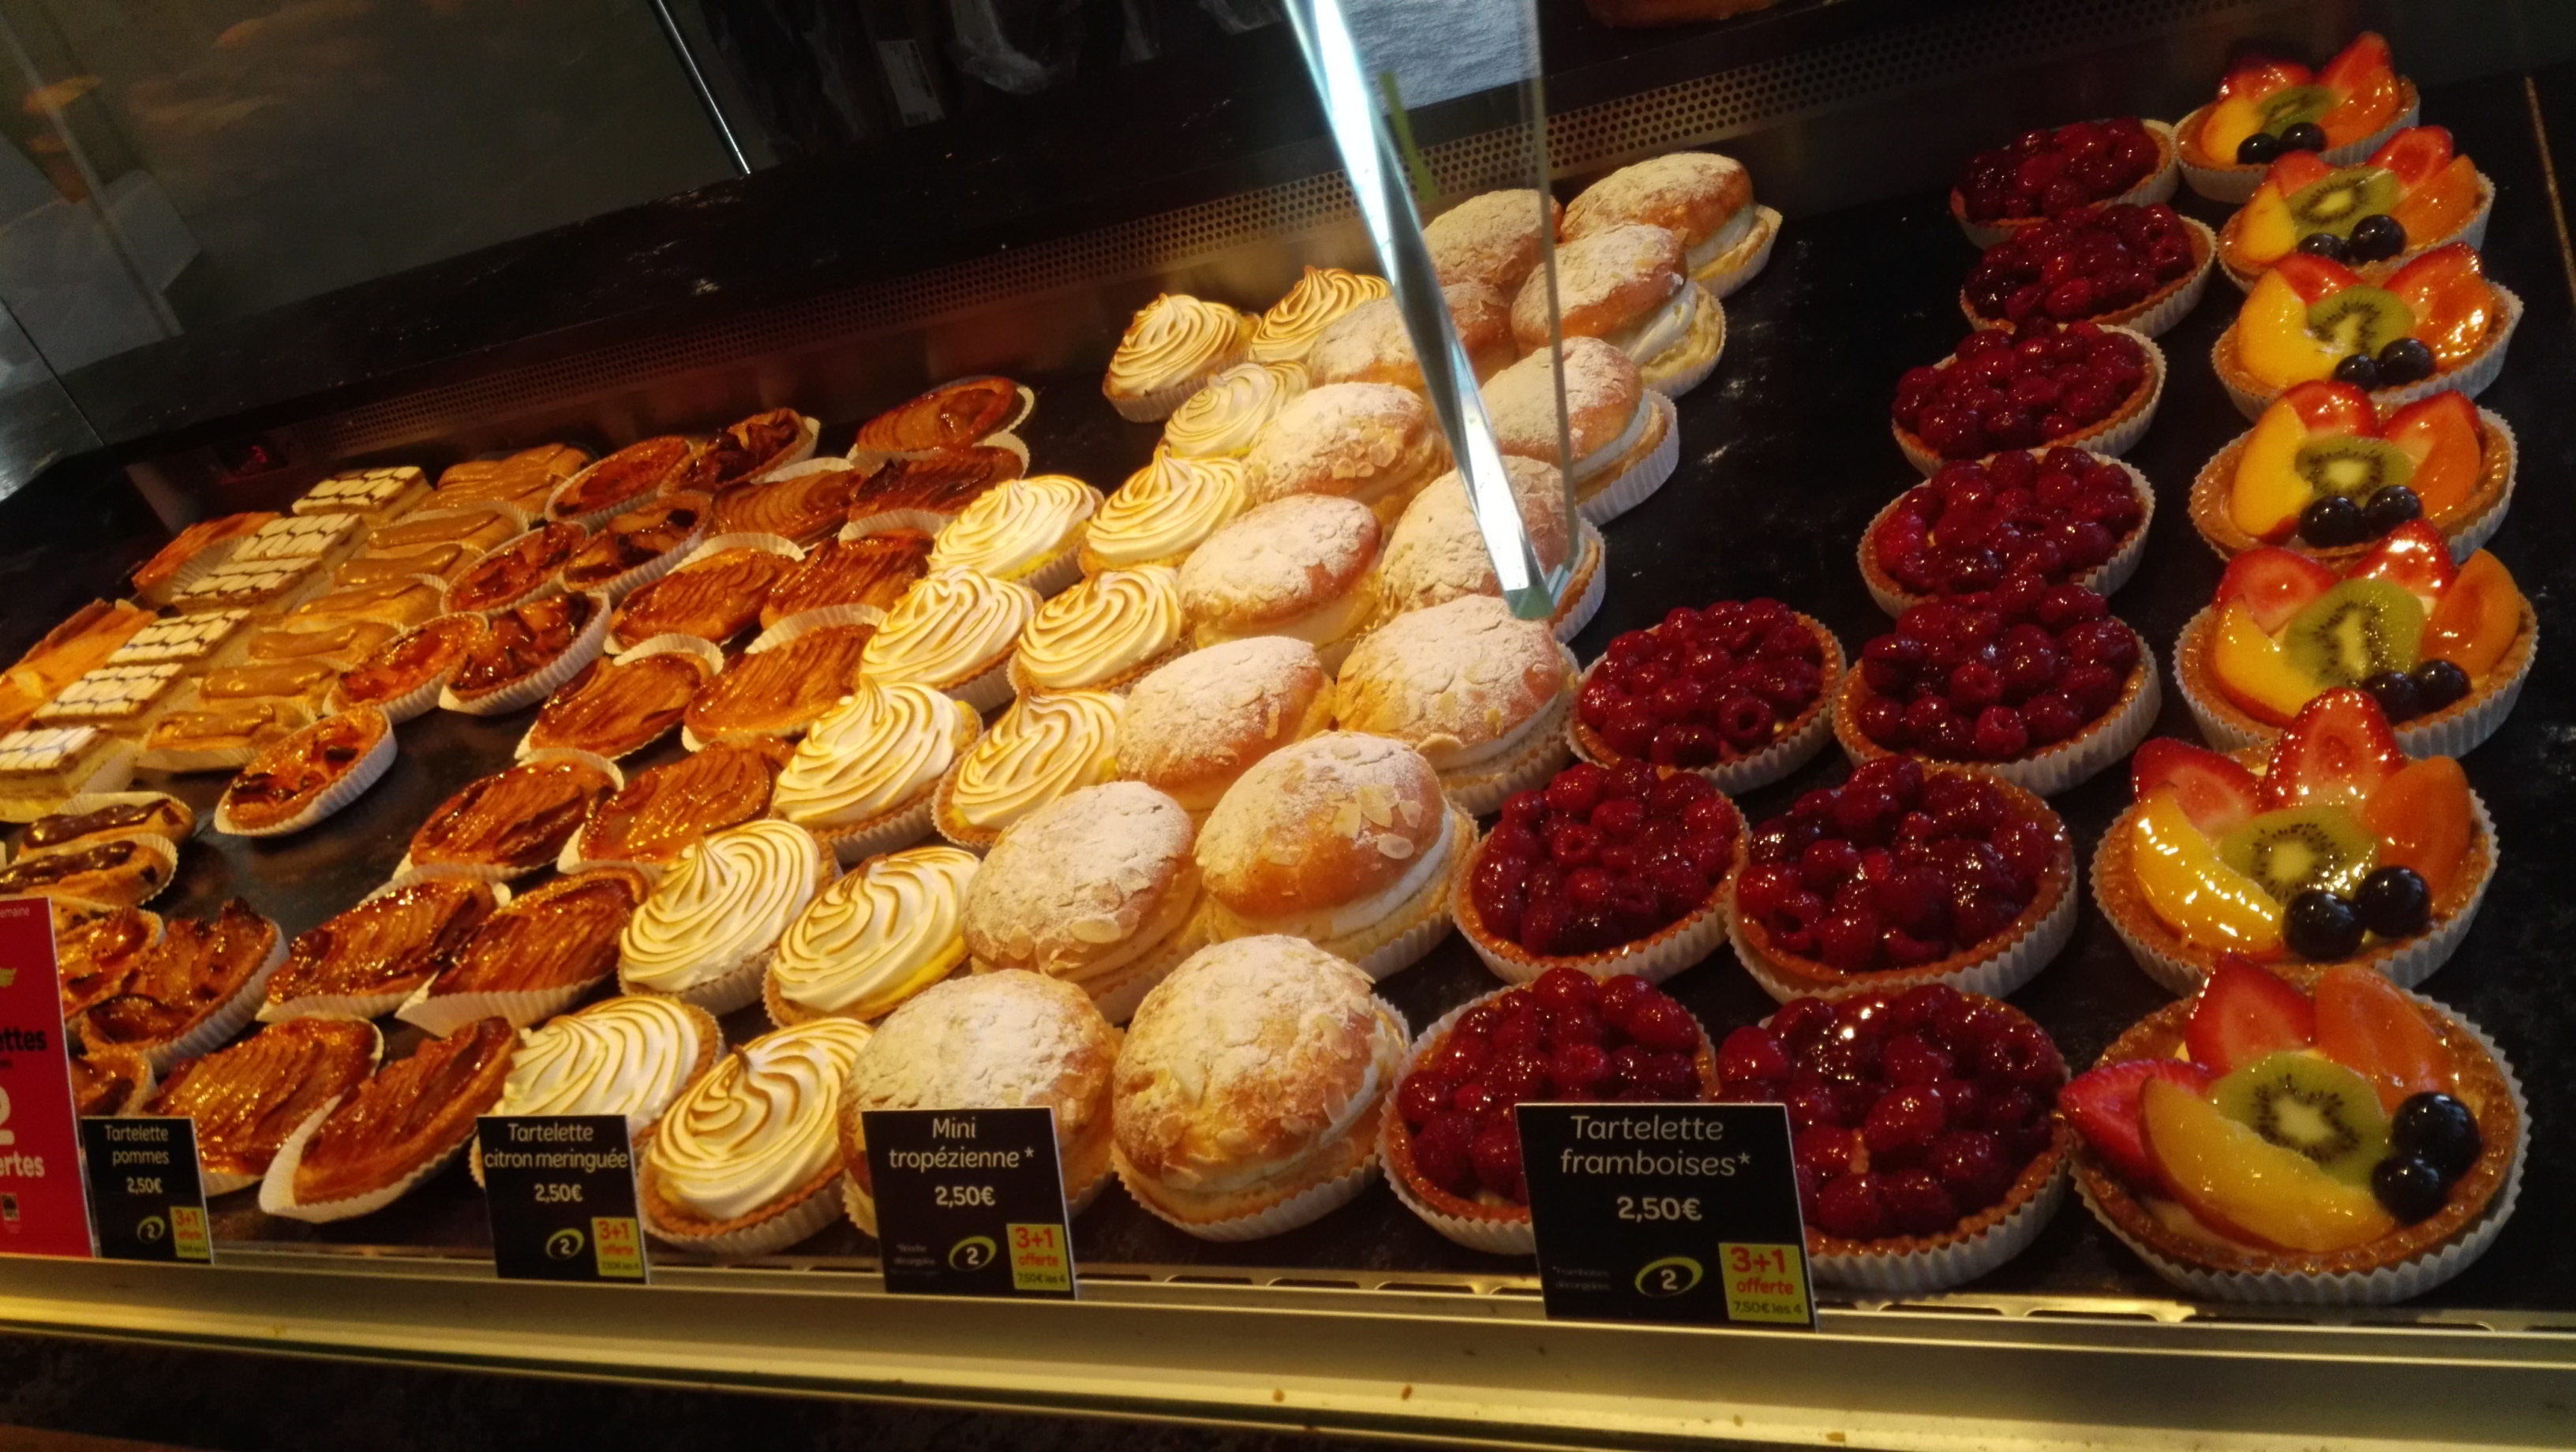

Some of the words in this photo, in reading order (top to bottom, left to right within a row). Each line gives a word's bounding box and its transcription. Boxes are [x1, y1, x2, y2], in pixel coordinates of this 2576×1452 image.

[104, 1125, 169, 1142] Tartelette
[507, 1123, 594, 1142] Tartelette
[931, 1117, 976, 1139] Mini
[1570, 1113, 1724, 1141] Tartelette
[112, 1150, 170, 1167] pommes
[484, 1148, 533, 1168] citron
[537, 1147, 629, 1173] meringuée
[126, 1177, 163, 1195] 2,50€
[534, 1183, 584, 1203] 2,50€
[934, 1185, 996, 1209] 2,50€
[174, 1209, 198, 1226] 3+1
[1616, 1196, 1703, 1224] 2,50€
[597, 1220, 630, 1241] 3+1
[1015, 1226, 1054, 1249] 3+1
[559, 1237, 571, 1256] 2
[966, 1247, 980, 1266] 2
[1017, 1252, 1059, 1267] offerte
[1730, 1246, 1787, 1274] 3+1
[1660, 1269, 1679, 1290] 2
[1735, 1277, 1794, 1296] offerte
[1732, 1300, 1769, 1314] 7,50€
[1772, 1302, 1791, 1314] les
[1793, 1304, 1803, 1315] 4
